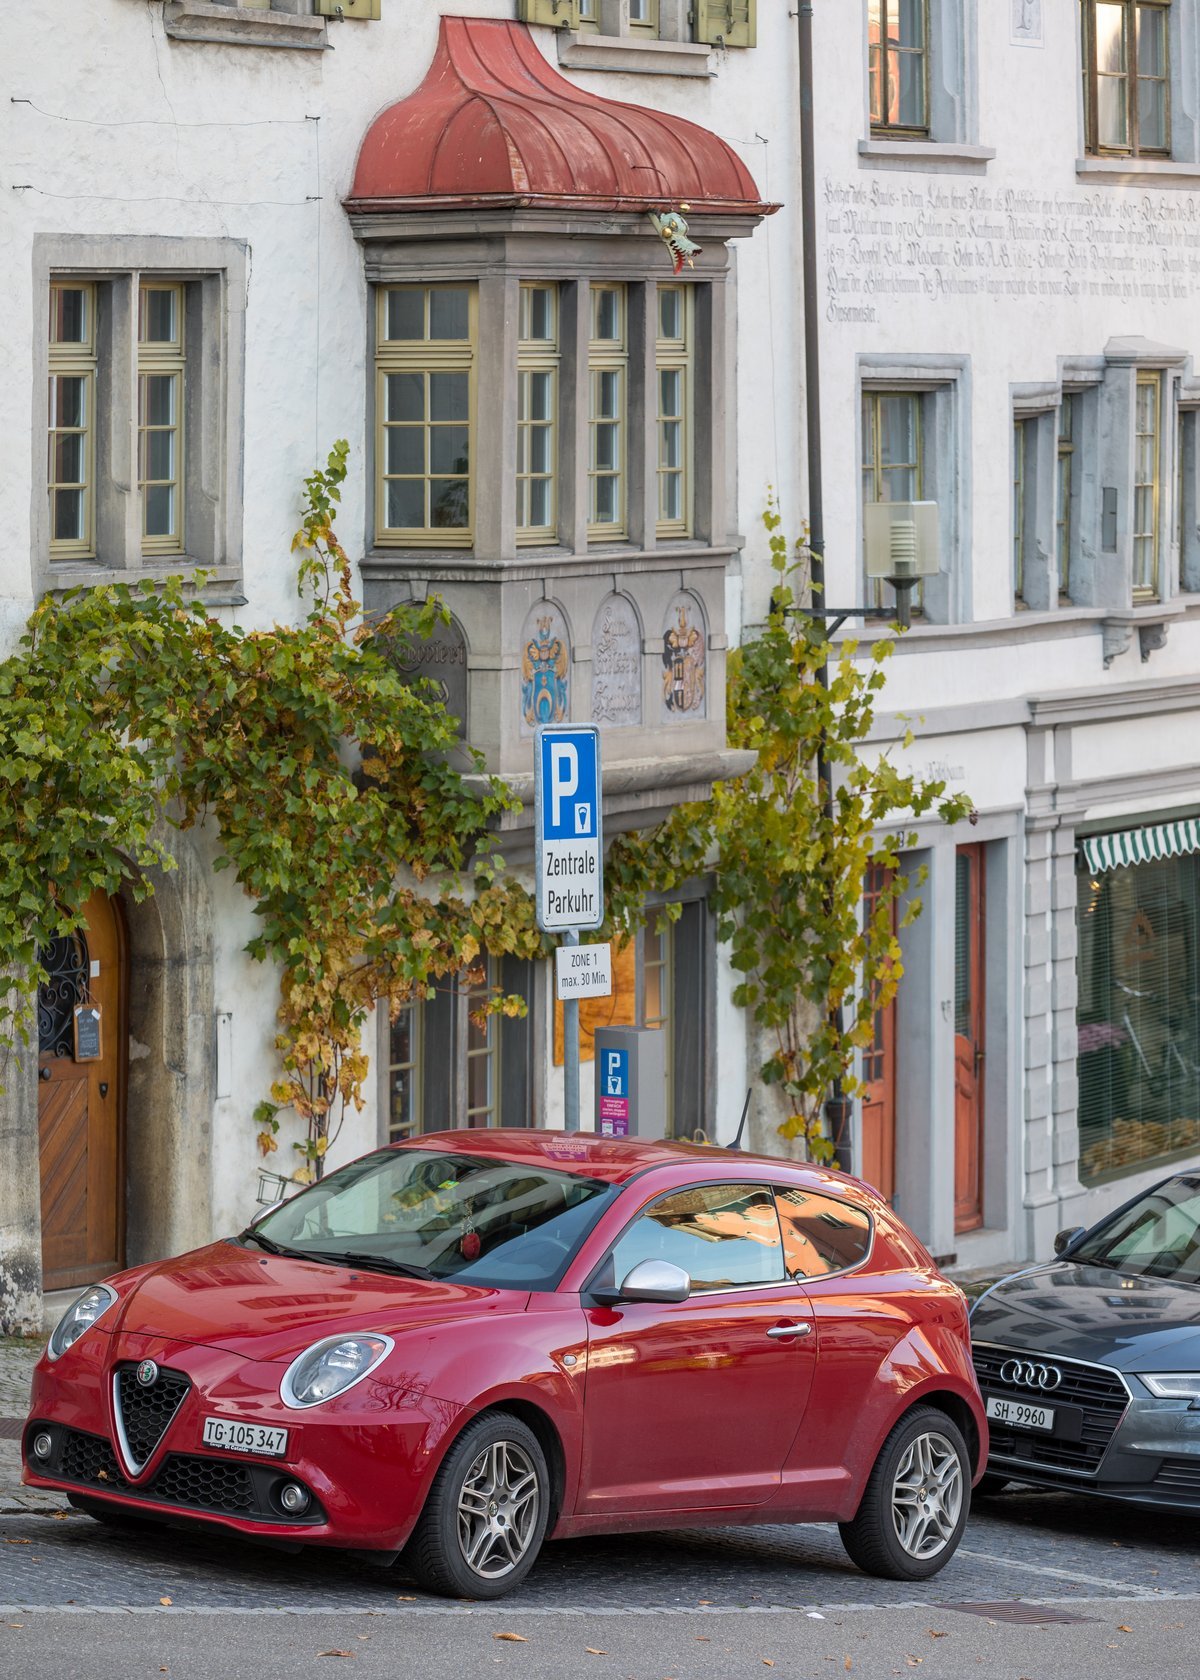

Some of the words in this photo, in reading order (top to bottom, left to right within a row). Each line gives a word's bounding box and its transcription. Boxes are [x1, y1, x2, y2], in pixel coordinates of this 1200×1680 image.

[550, 742, 579, 827] P
[546, 850, 595, 877] Zentrale
[548, 888, 594, 915] Parkuhr
[571, 953, 590, 967] ZONE
[593, 952, 598, 966] 1
[561, 976, 580, 988] max.
[581, 972, 590, 986] 30
[591, 970, 608, 985] Min.
[608, 1052, 621, 1076] P
